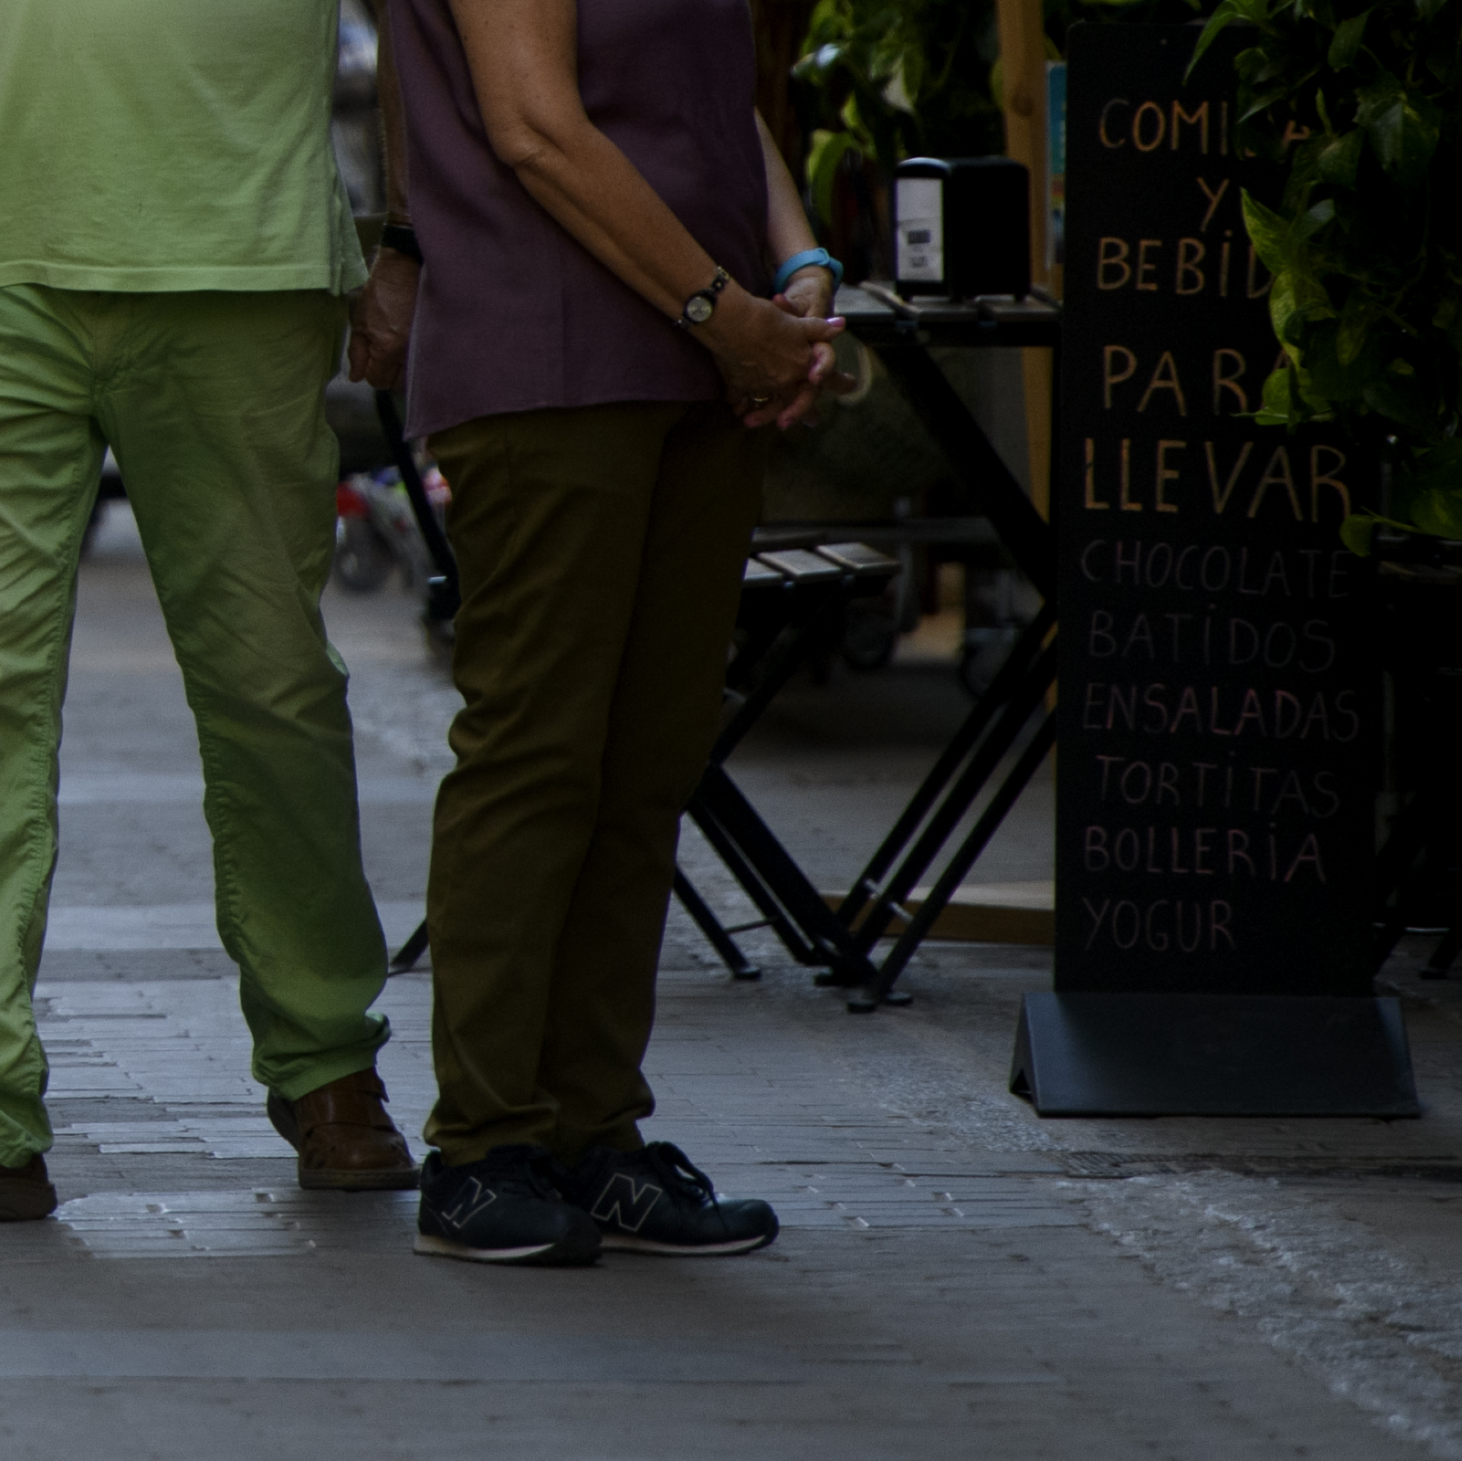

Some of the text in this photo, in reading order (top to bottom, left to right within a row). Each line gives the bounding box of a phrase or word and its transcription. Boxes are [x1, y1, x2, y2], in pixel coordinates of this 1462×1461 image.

[1196, 176, 1230, 232] Y
[1096, 230, 1276, 299] BEBID
[1101, 344, 1295, 417] PAR
[1083, 437, 1353, 524] LLEVAR
[1080, 539, 1353, 599] CHOCOLATE
[1082, 682, 1361, 742] ENSALADAS
[1095, 749, 1341, 819] TORTITAS
[1082, 897, 1237, 955] YOGUR
[590, 1172, 664, 1233] N
